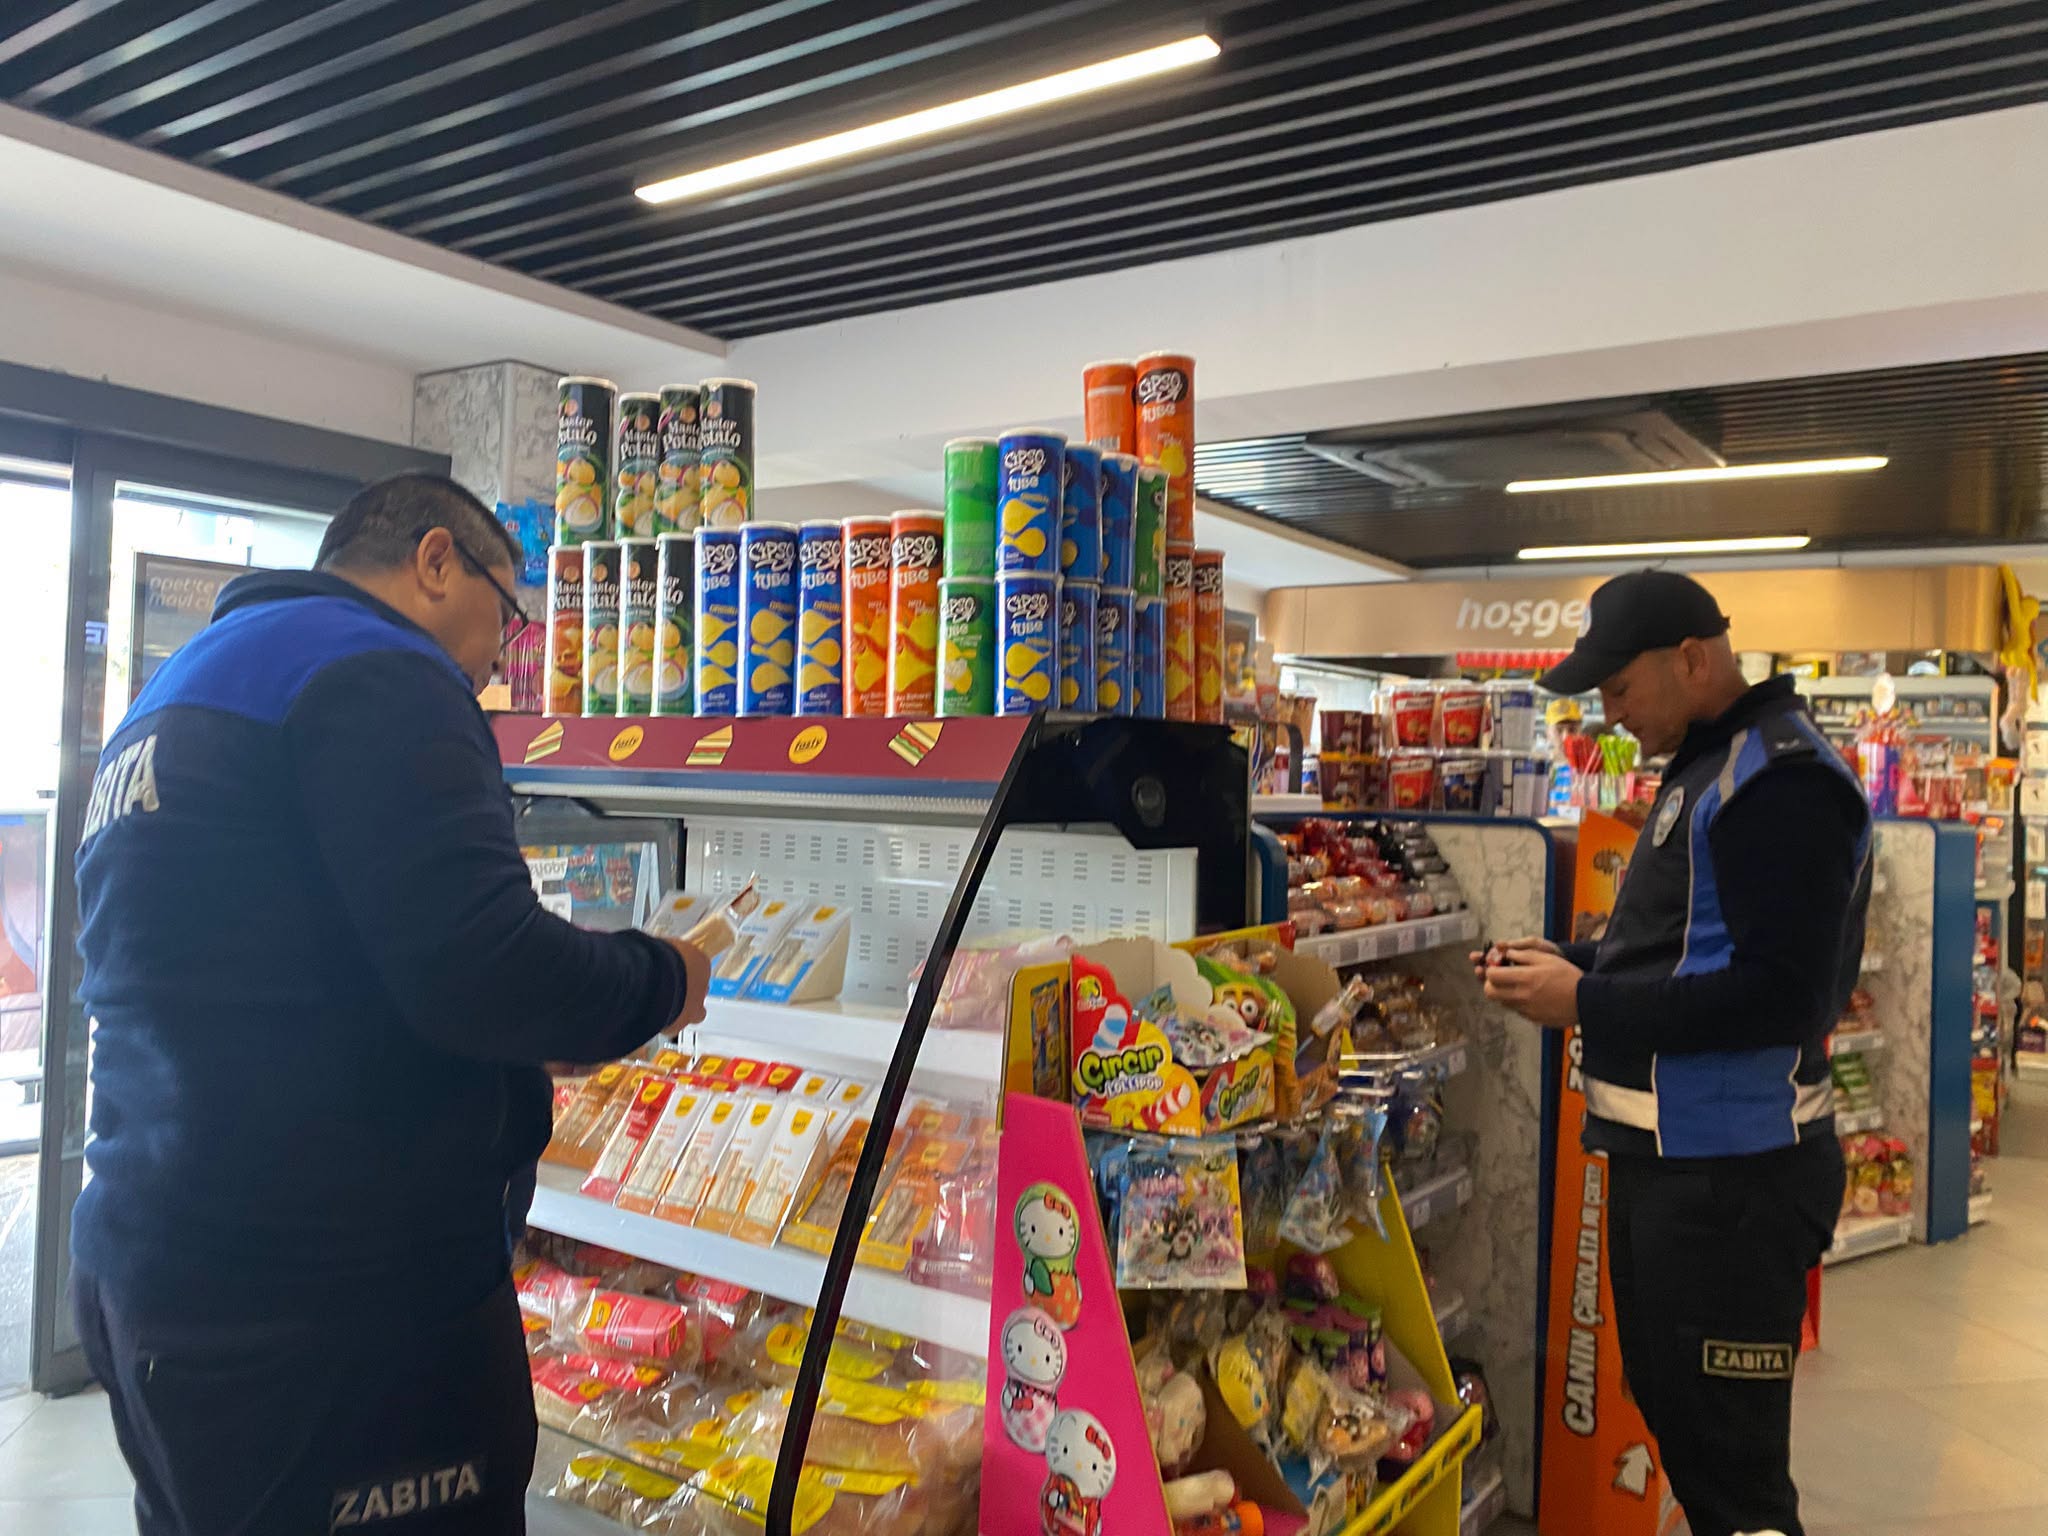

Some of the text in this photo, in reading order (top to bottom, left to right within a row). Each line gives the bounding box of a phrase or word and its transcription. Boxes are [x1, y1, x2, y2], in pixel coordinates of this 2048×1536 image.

[1456, 598, 1583, 638] hoşge
[1714, 1348, 1783, 1370] ZABITA
[333, 1463, 481, 1527] ZABITA
